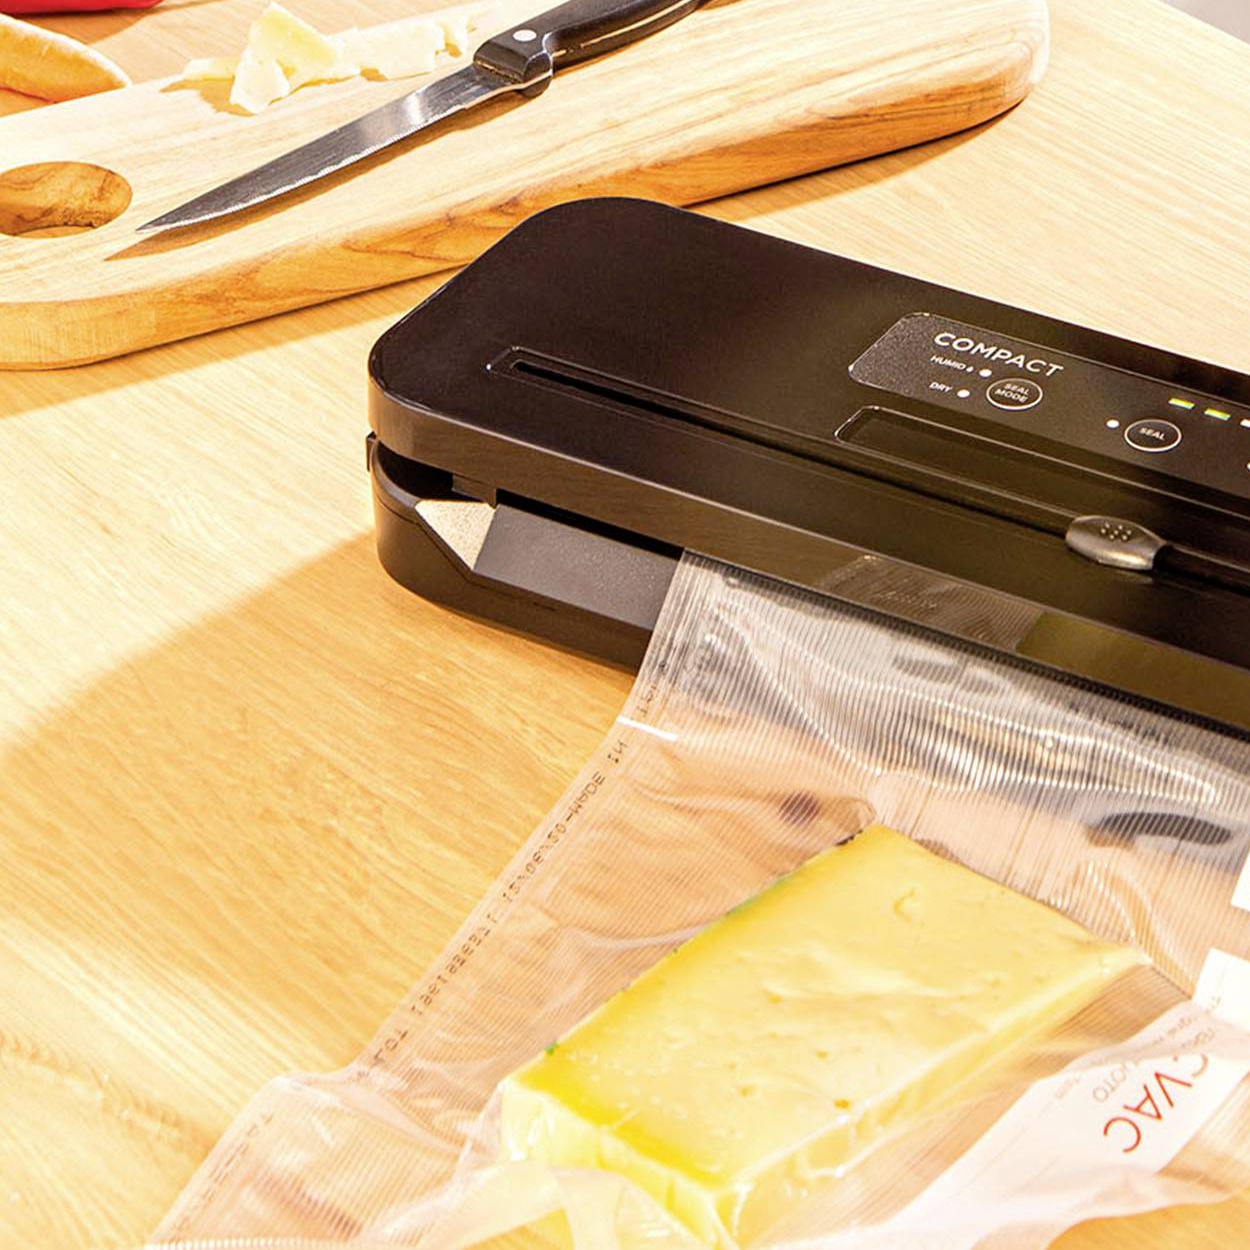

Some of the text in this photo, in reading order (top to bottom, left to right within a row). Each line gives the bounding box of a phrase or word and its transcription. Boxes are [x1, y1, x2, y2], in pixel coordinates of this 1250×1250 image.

[933, 332, 1065, 377] COMPACT
[929, 354, 967, 371] HUMID
[929, 381, 953, 394] DRY
[1003, 382, 1030, 396] SEAL
[994, 388, 1028, 403] MODE
[1138, 426, 1166, 441] SEAL
